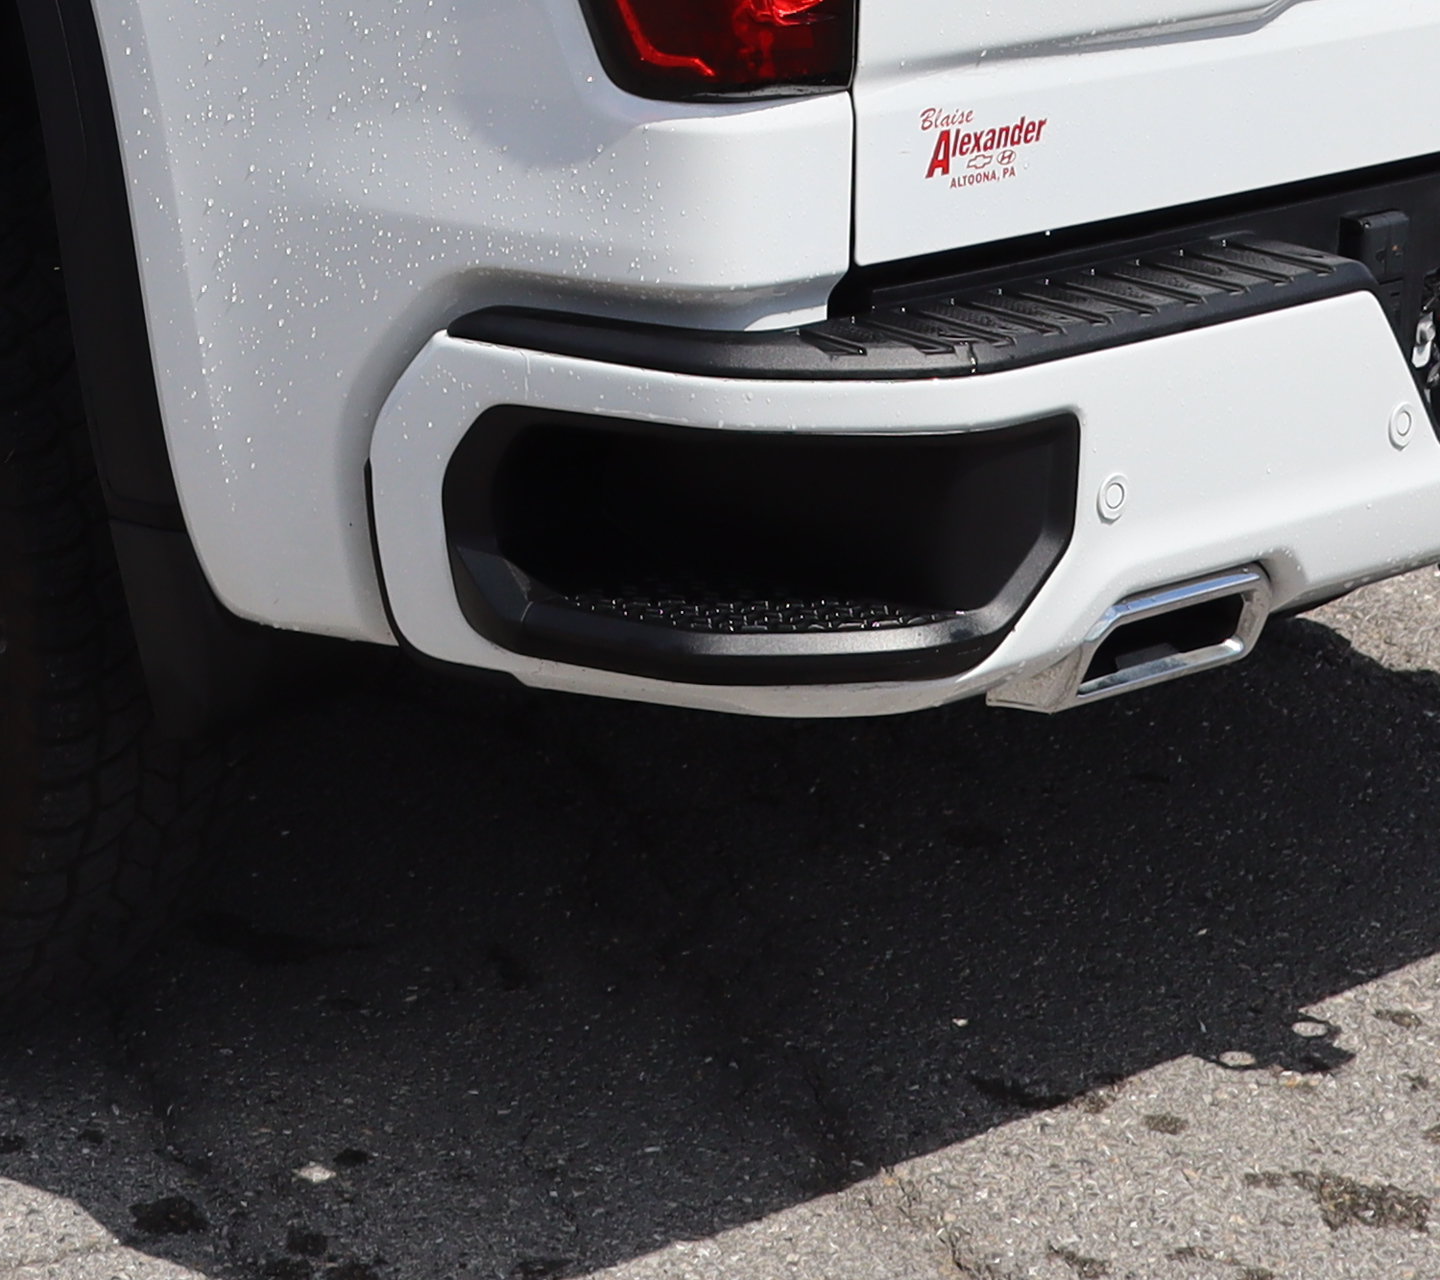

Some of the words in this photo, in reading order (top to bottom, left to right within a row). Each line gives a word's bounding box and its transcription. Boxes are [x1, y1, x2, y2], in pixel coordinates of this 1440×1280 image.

[920, 107, 974, 131] Blaise
[925, 115, 1048, 179] Alexander
[950, 170, 1000, 189] ALTOONA,
[1002, 165, 1016, 179] PA
